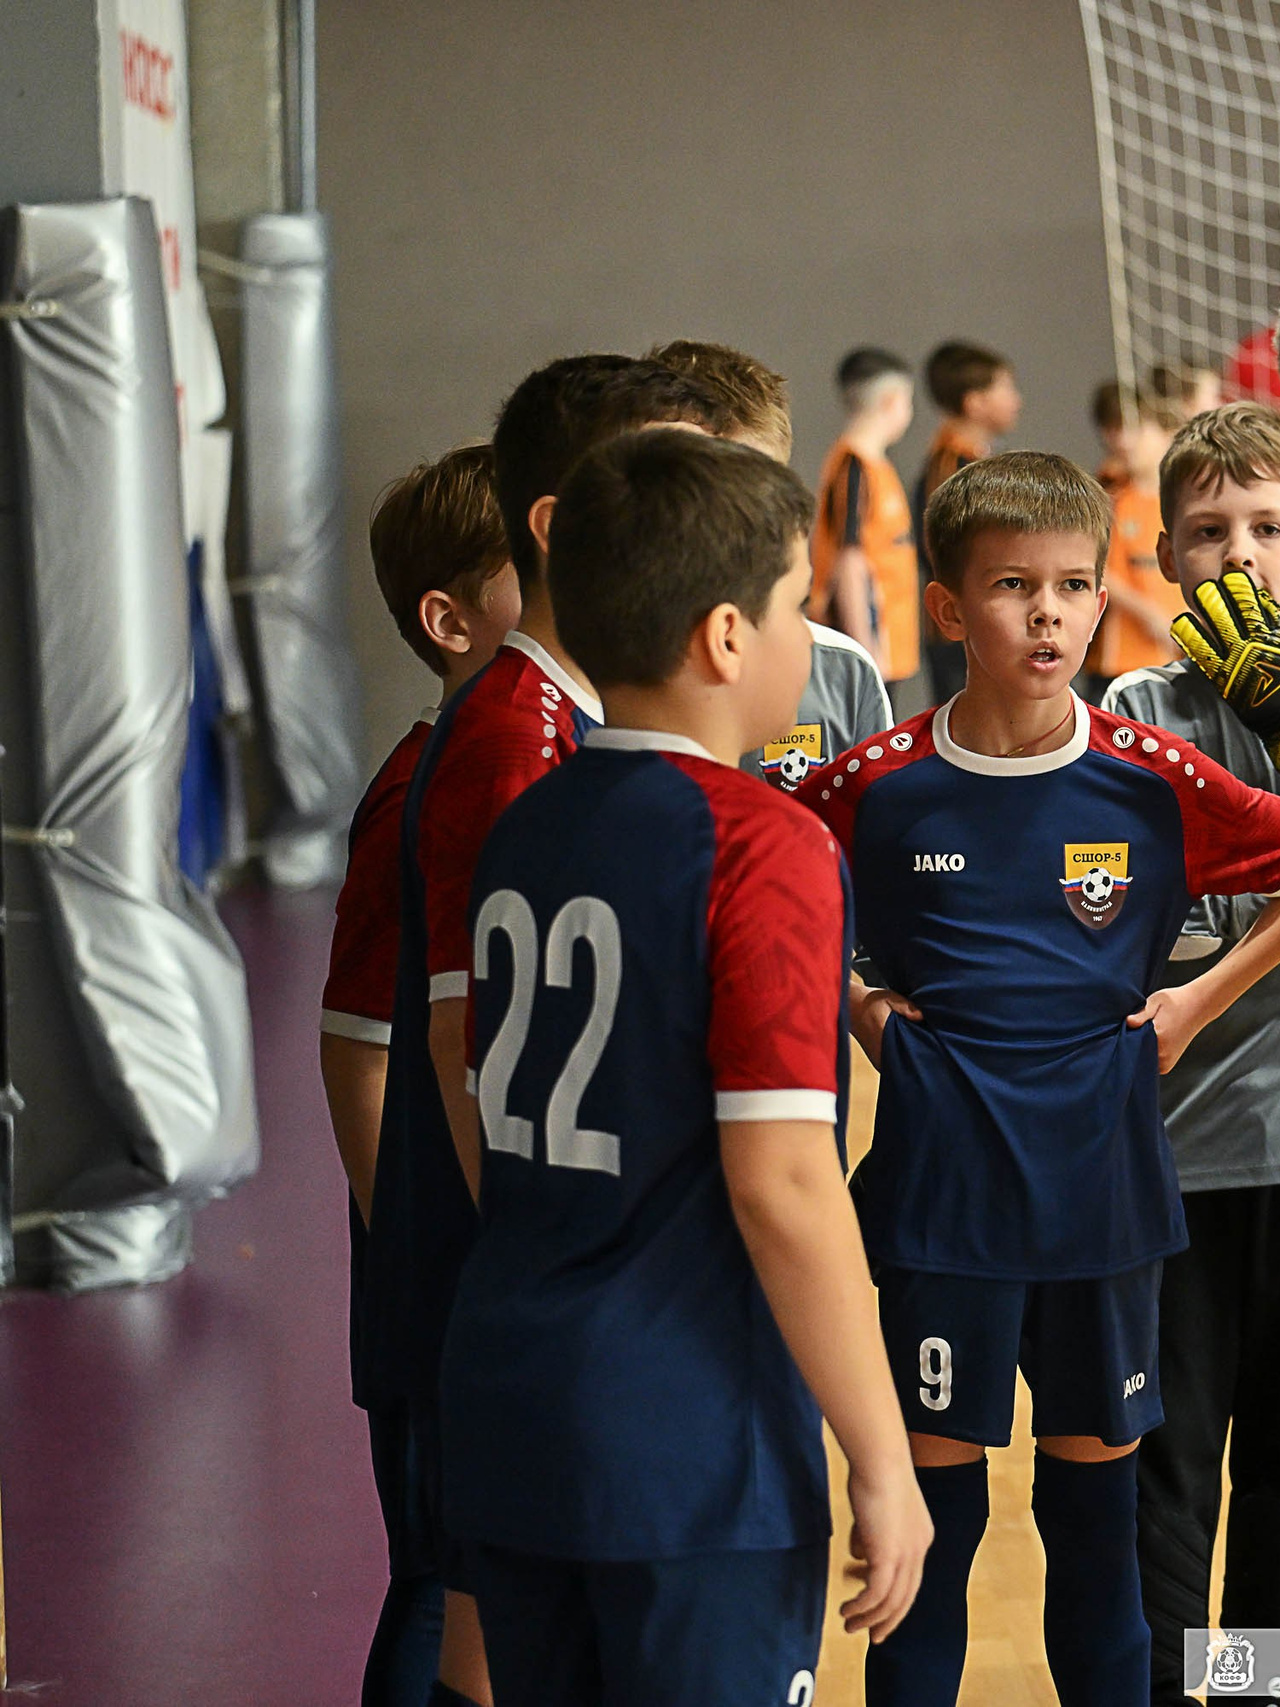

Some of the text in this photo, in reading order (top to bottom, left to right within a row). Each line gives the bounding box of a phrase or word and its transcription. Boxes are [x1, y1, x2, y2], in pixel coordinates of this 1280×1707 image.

[913, 853, 966, 872] JAKO
[1072, 852, 1122, 863] СШОР-5
[474, 888, 623, 1178] 22
[919, 1336, 953, 1412] 9
